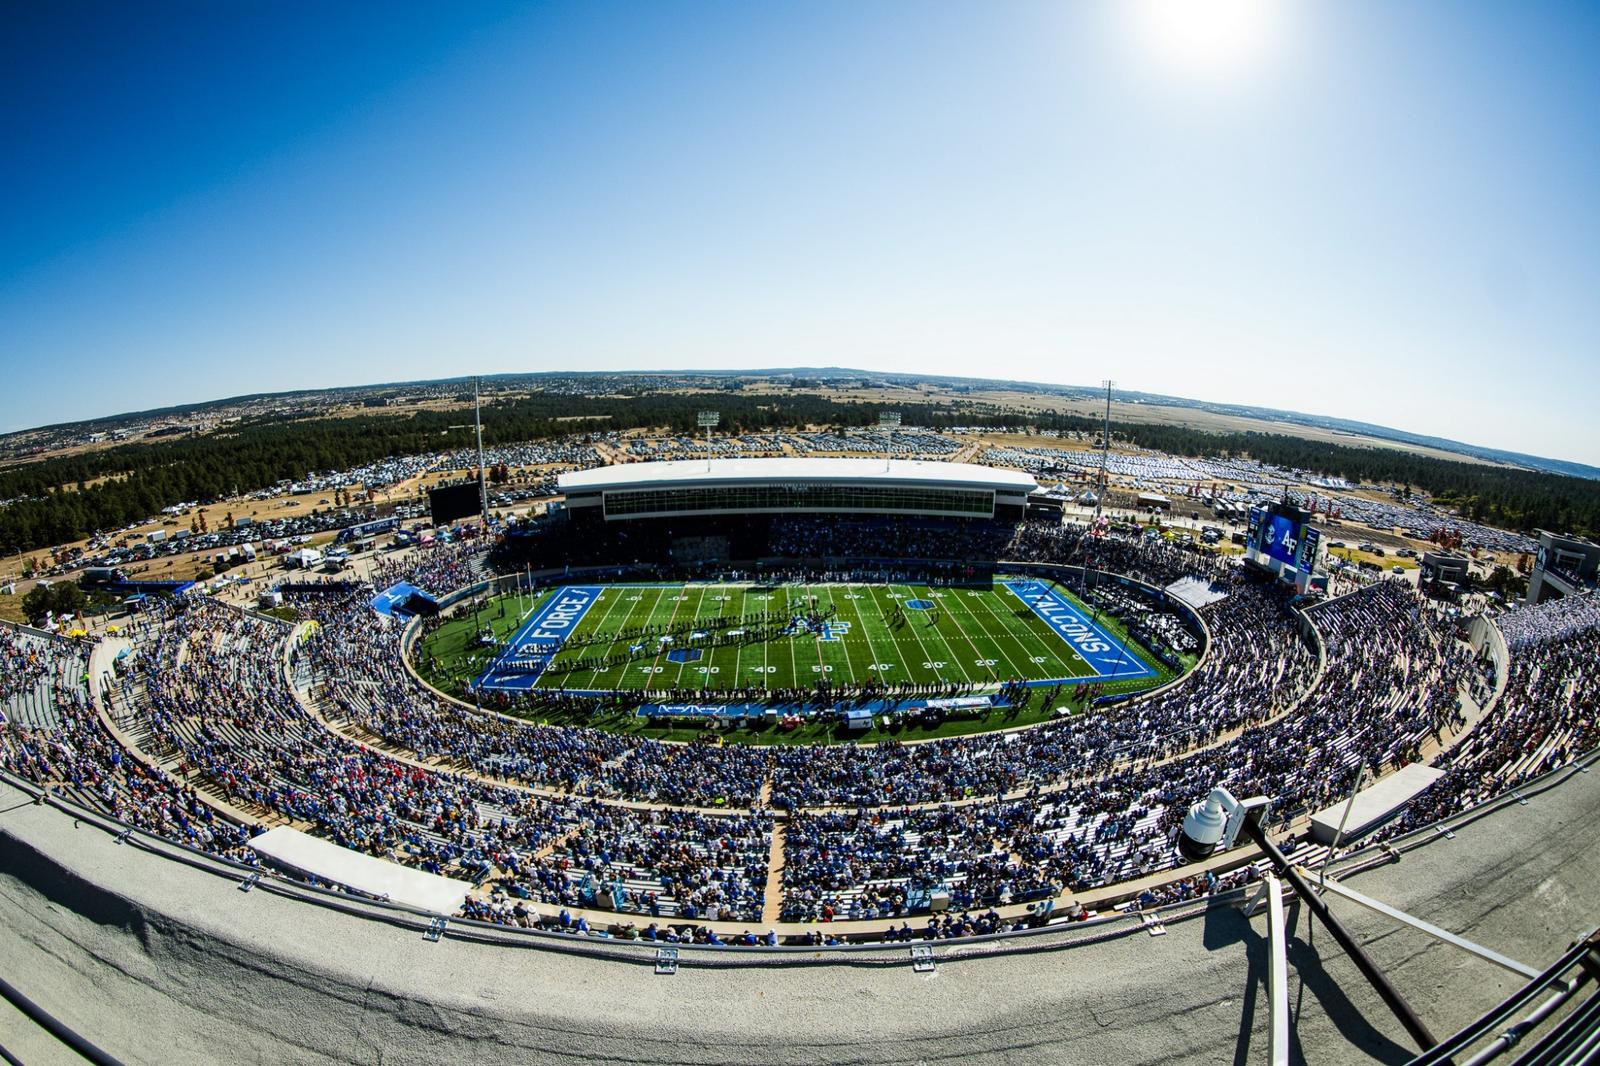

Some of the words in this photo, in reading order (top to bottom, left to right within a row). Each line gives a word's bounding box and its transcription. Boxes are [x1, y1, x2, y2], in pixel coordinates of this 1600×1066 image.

[1281, 530, 1297, 555] AF
[531, 596, 589, 638] FORCE
[1025, 594, 1111, 653] FALCONS
[1029, 656, 1044, 664] 10
